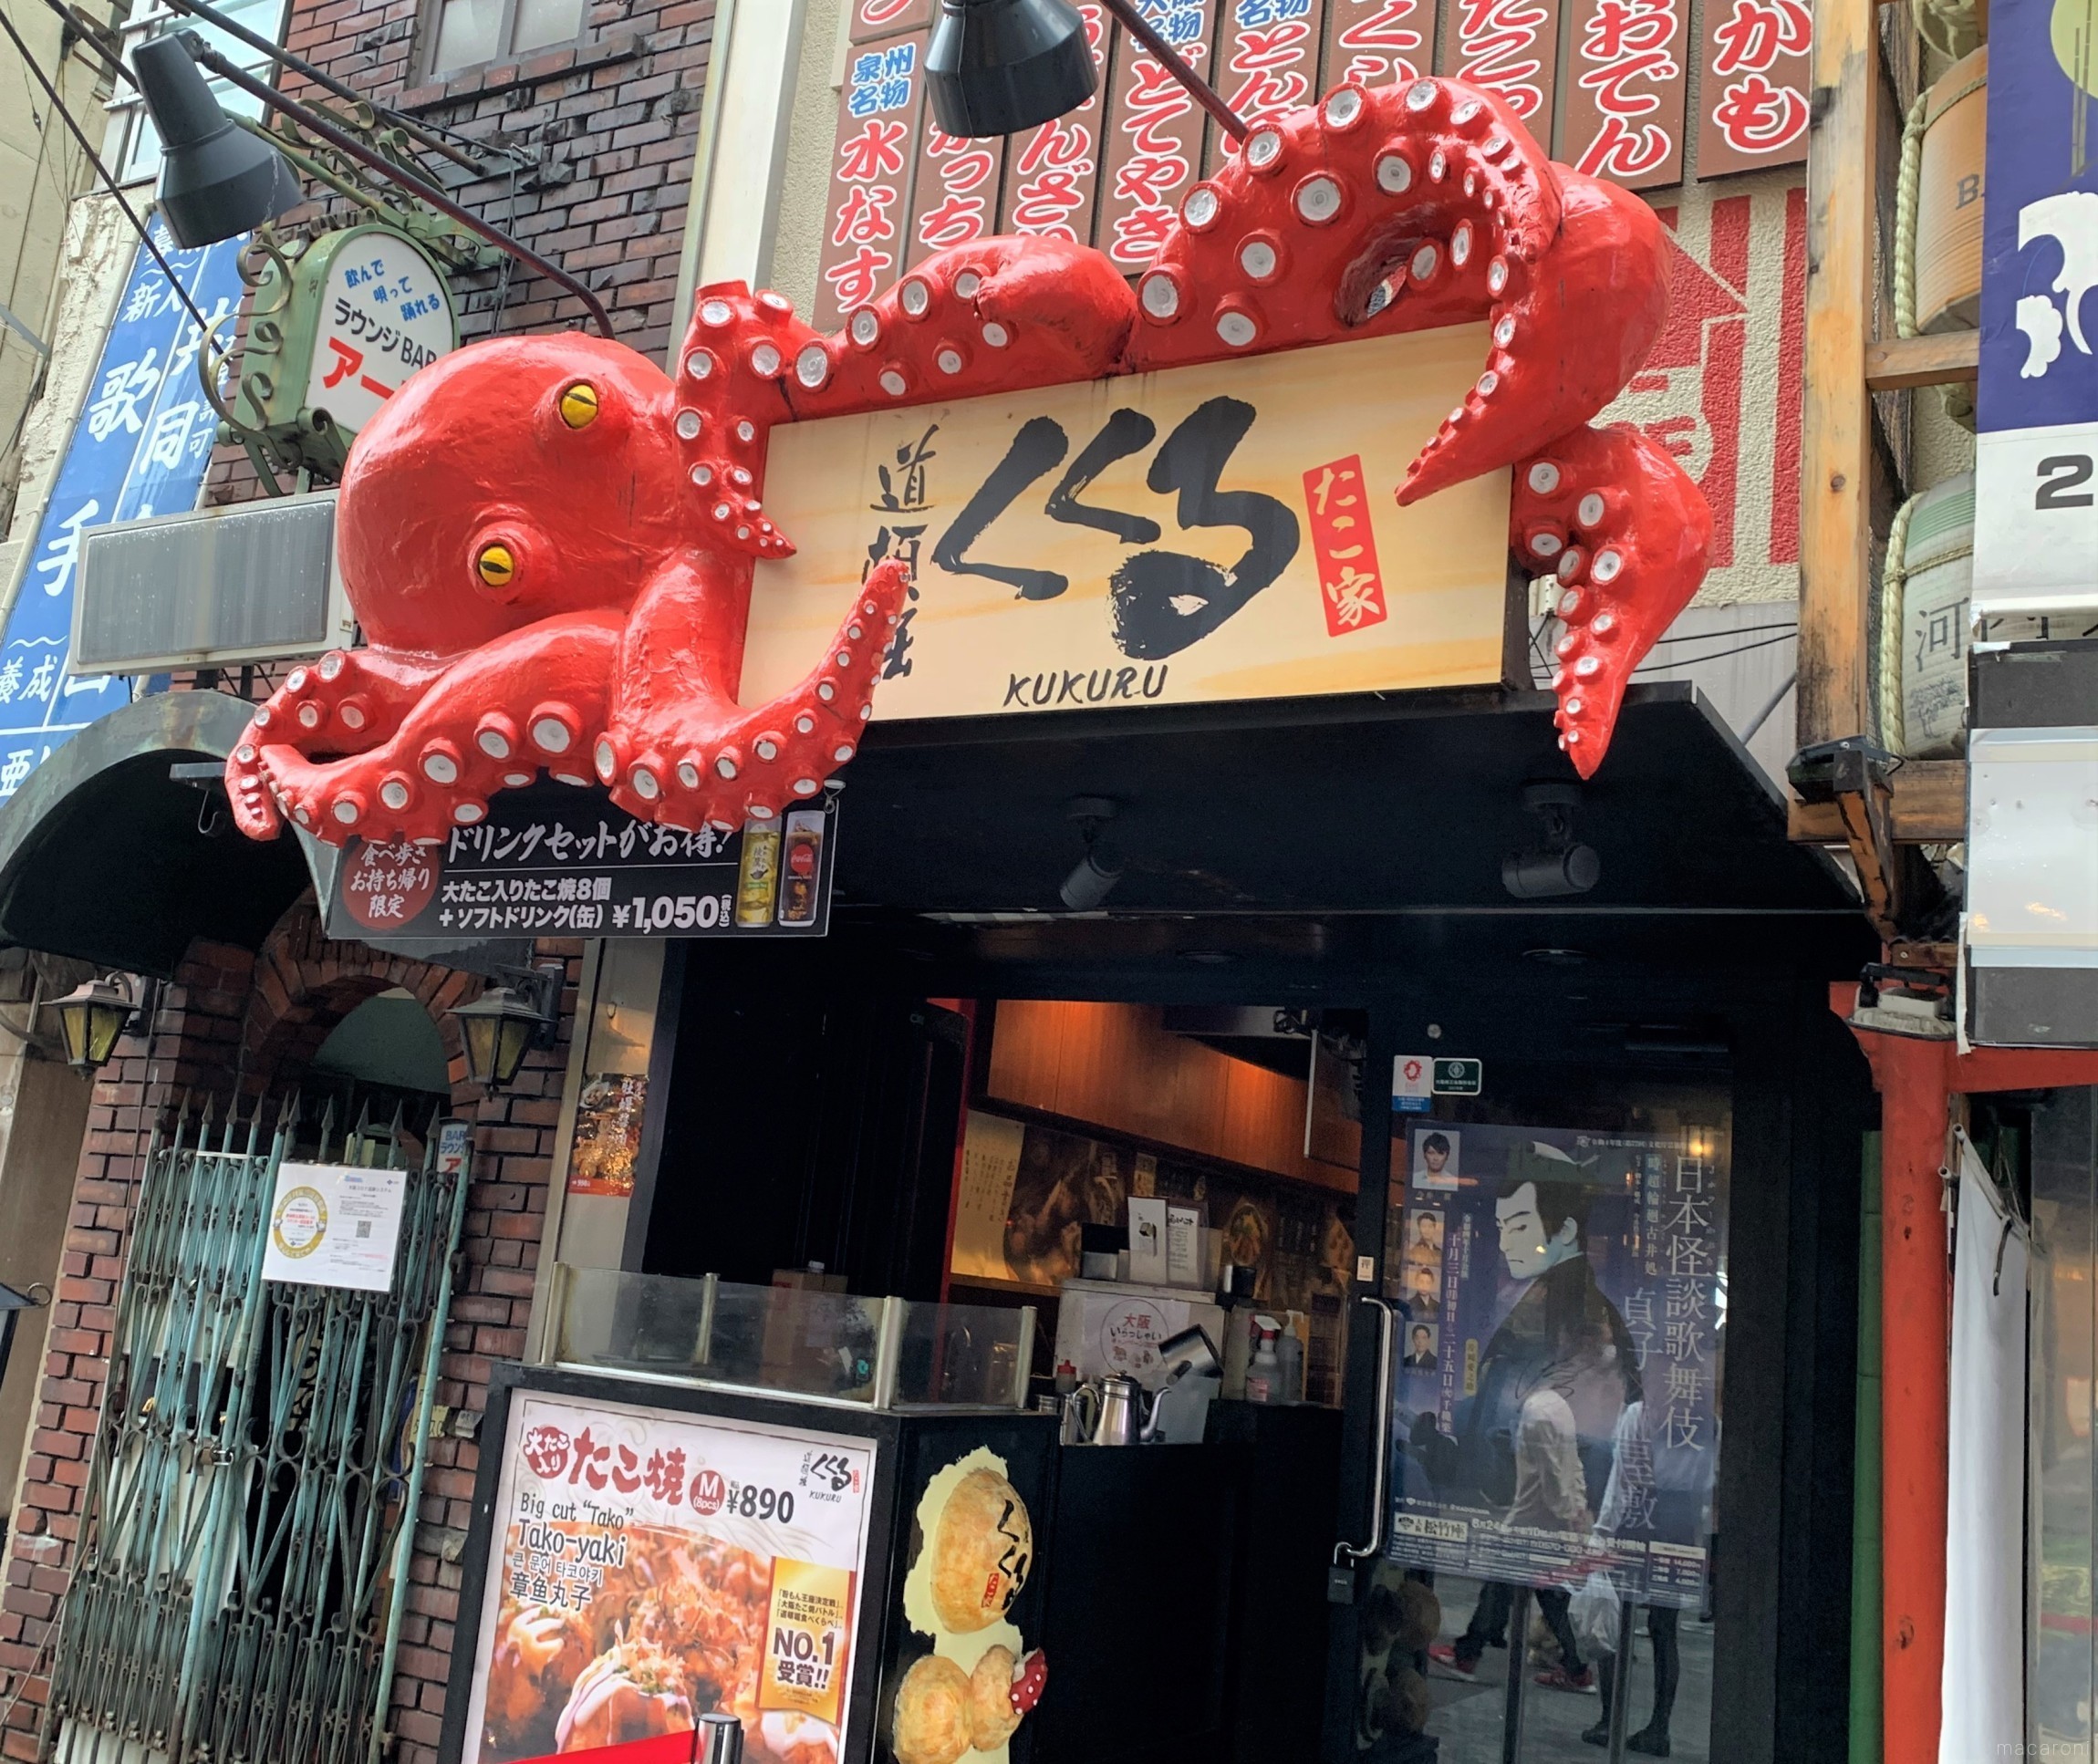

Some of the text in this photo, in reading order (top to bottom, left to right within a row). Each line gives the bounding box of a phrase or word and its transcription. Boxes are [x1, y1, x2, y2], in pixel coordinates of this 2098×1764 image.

[851, 42, 916, 86] 泉州
[848, 77, 912, 118] 名物
[1575, 0, 1681, 178] おでん
[1110, 42, 1208, 262] どてやき
[825, 119, 908, 314] 水なす
[344, 259, 386, 289] 飲んで
[372, 276, 413, 304] 唄って
[121, 275, 183, 323] 新人
[400, 293, 441, 322] 踊れる
[323, 336, 408, 400] アー
[2034, 453, 2094, 510] 2
[932, 395, 1301, 661] くくる
[1312, 465, 1382, 630] たこ家
[1002, 664, 1169, 708] KUKURU
[350, 866, 431, 893] お持ち帰り
[441, 877, 613, 903] 大たこ入りたこ焼8個
[368, 894, 405, 918] 限定
[612, 895, 720, 934] ¥1,050
[1123, 1313, 1151, 1330] 大阪
[1659, 1155, 1713, 1451] 日本怪談歌舞伎
[1110, 1326, 1162, 1340] いらっしゃい
[524, 1427, 570, 1456] 大たこ
[536, 1453, 561, 1474] 入り
[568, 1427, 687, 1506] たこ焼
[810, 1453, 853, 1492] くくる
[692, 1494, 721, 1512] (8pcs)
[698, 1472, 720, 1499] M
[727, 1484, 795, 1524] ¥890
[809, 1489, 842, 1503] KUKURU
[520, 1492, 545, 1520] Big
[552, 1502, 576, 1522] cut
[518, 1518, 627, 1567] Tako-yaki
[513, 1551, 603, 1586] 큰 문어 타코야키
[510, 1571, 592, 1613] 章鱼丸子
[774, 1626, 836, 1666] NO.1
[777, 1659, 830, 1690] 受賞!!
